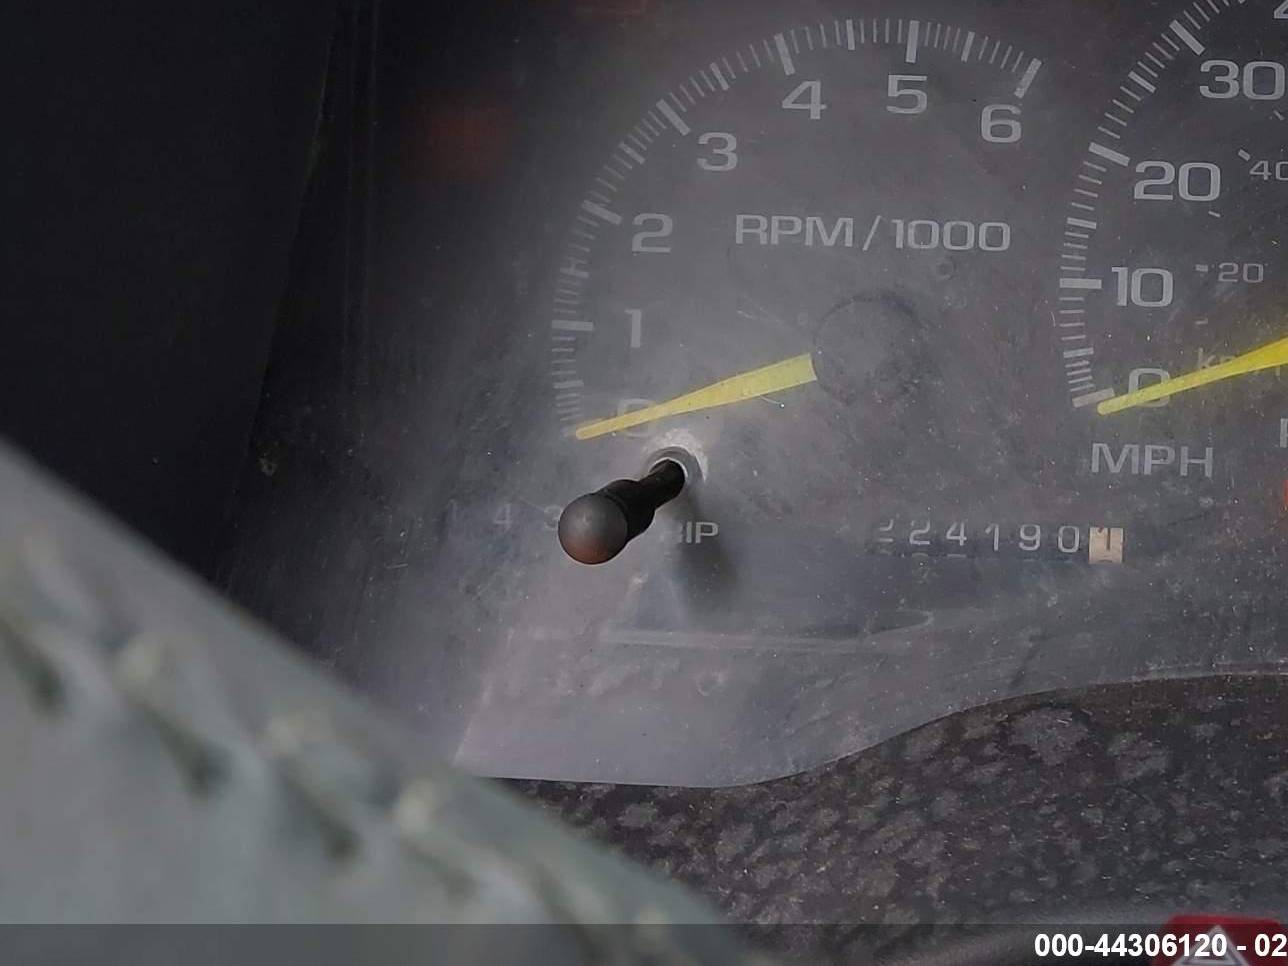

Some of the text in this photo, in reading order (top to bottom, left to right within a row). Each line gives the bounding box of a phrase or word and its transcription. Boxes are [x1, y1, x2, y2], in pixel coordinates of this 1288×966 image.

[887, 74, 928, 114] 5
[1200, 60, 1285, 100] 30
[782, 81, 826, 119] 4
[980, 104, 1022, 143] 6
[698, 133, 737, 170] 3
[1134, 161, 1221, 201] 20
[632, 214, 674, 253] 2
[736, 214, 1010, 251] RPM/1000
[1112, 267, 1173, 307] 10
[1218, 262, 1264, 283] 20
[625, 309, 641, 348] 1
[1091, 443, 1213, 478] MPH
